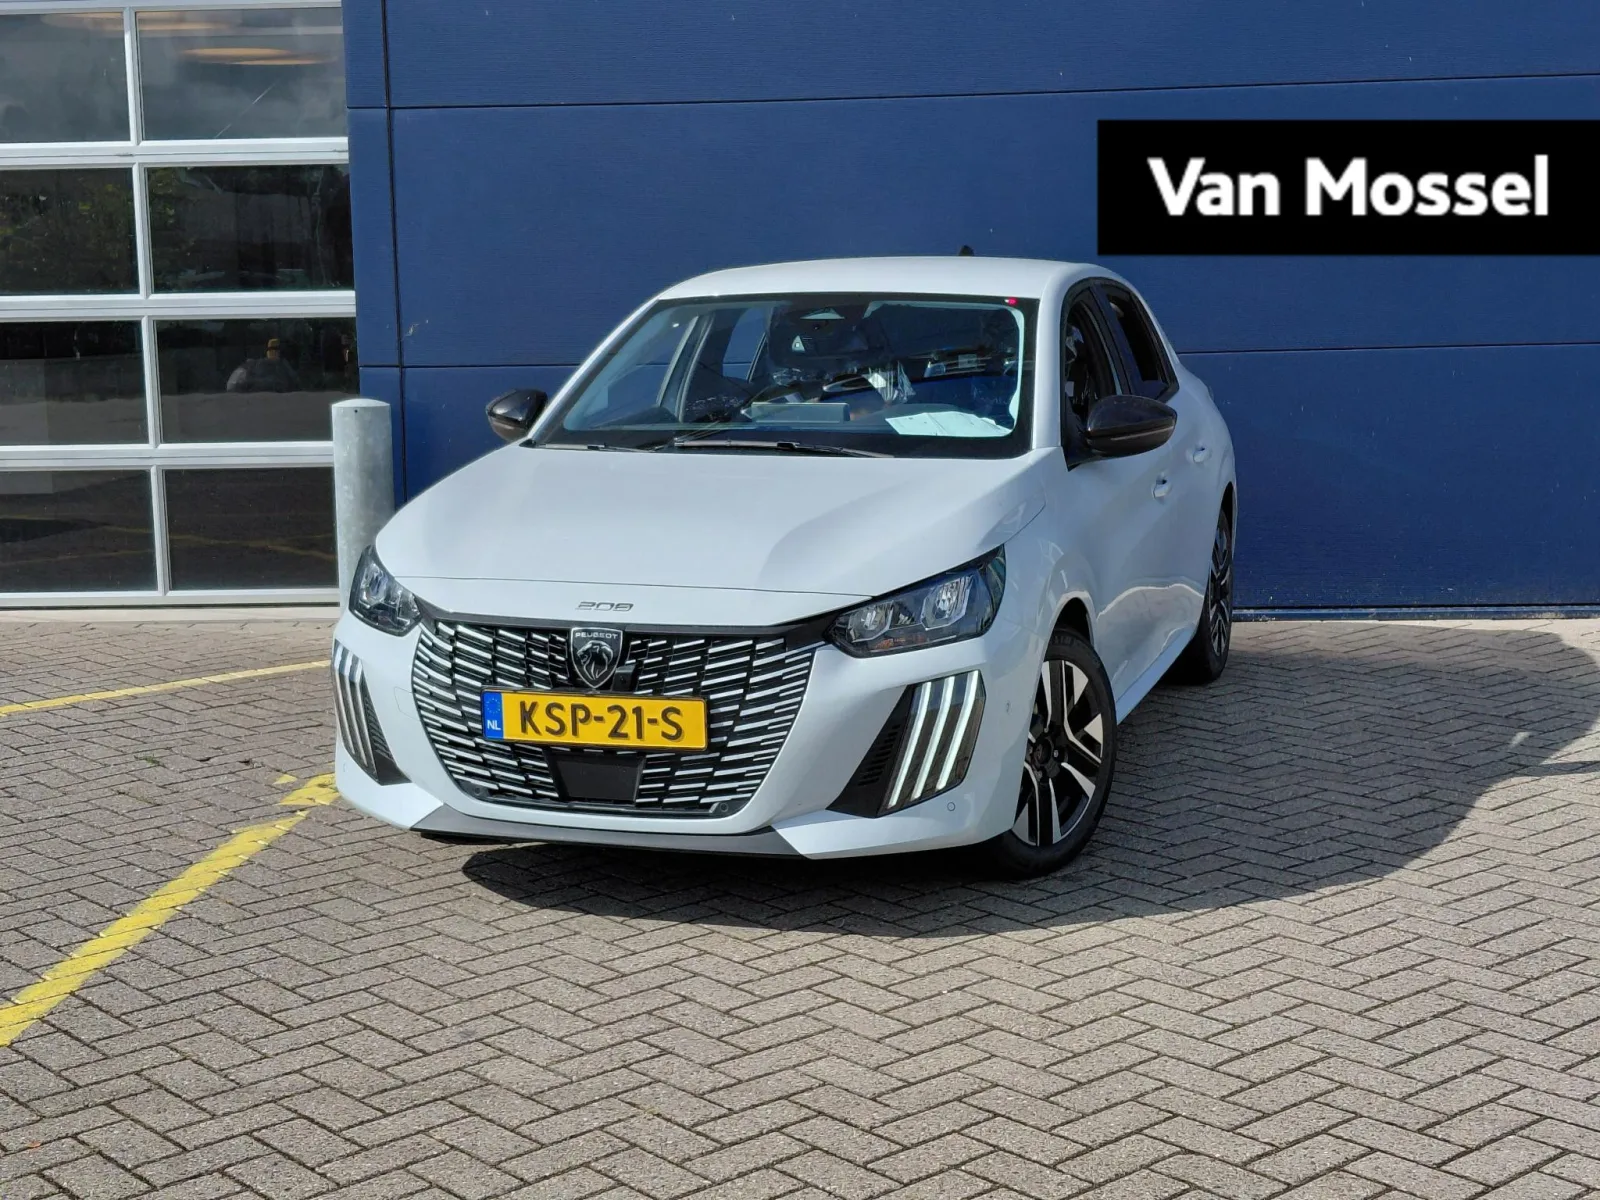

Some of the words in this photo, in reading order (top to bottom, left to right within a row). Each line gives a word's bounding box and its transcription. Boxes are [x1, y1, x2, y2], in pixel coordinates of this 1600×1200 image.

[575, 601, 634, 612] 208
[487, 720, 501, 731] NL
[519, 701, 683, 741] KSP-21-S
